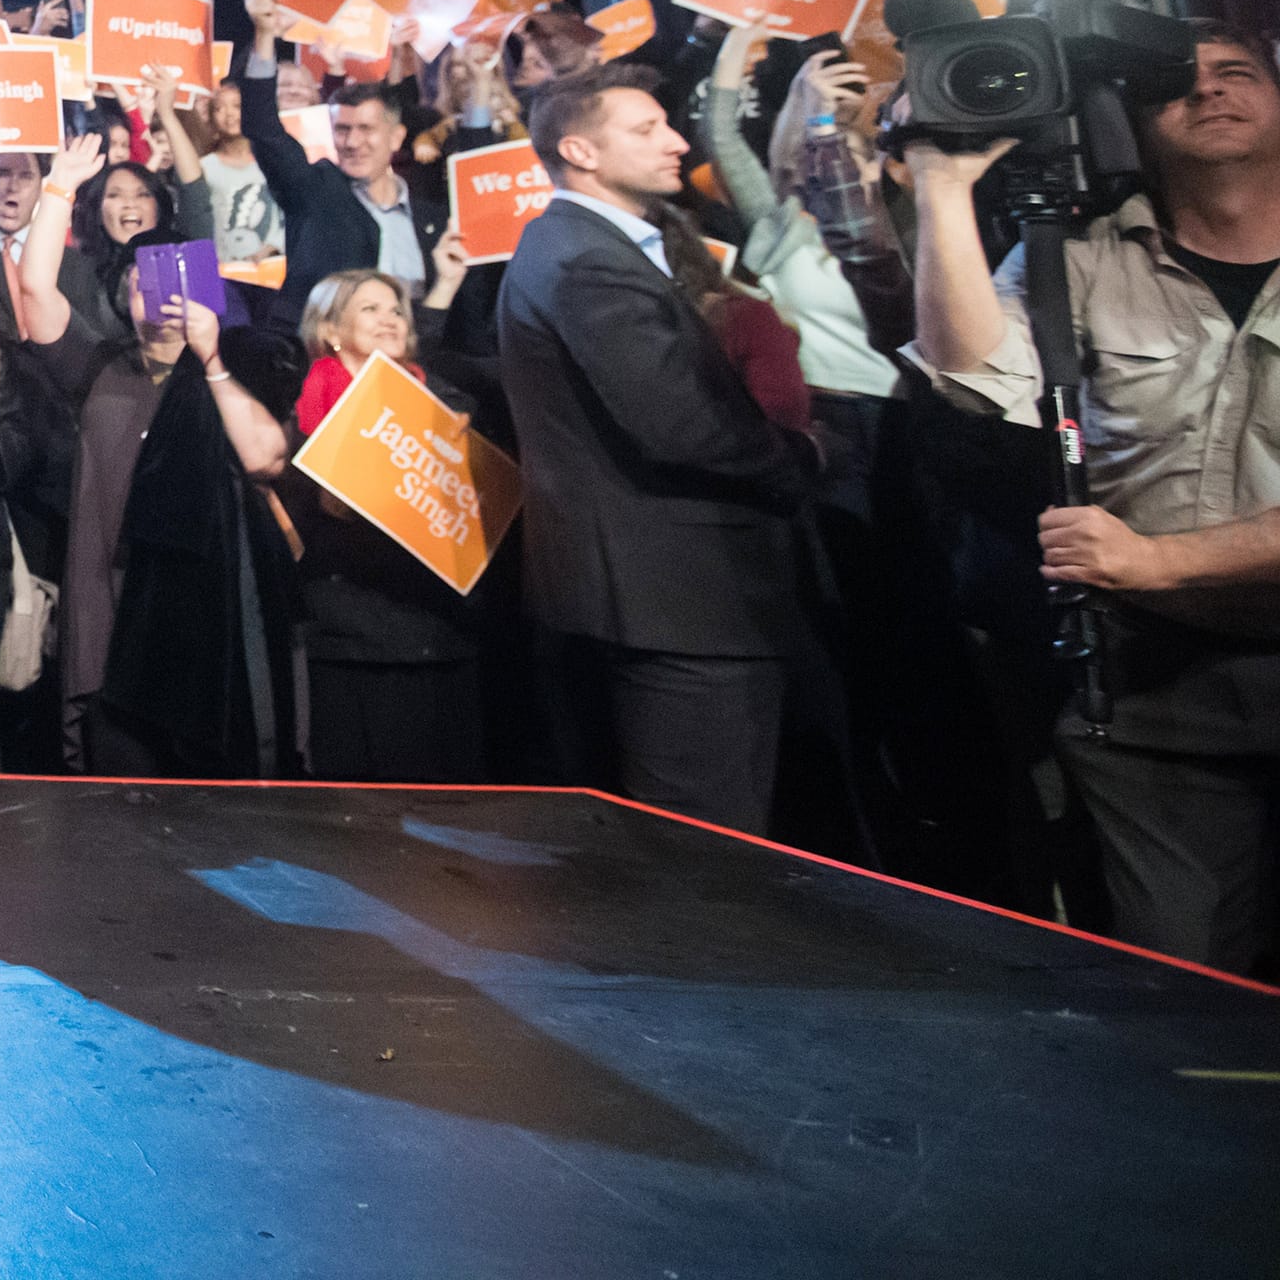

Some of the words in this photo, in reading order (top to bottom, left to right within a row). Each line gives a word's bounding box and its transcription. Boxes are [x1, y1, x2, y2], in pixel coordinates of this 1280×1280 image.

[471, 172, 512, 195] We
[1063, 428, 1082, 464] Global
[394, 472, 469, 545] Singh
